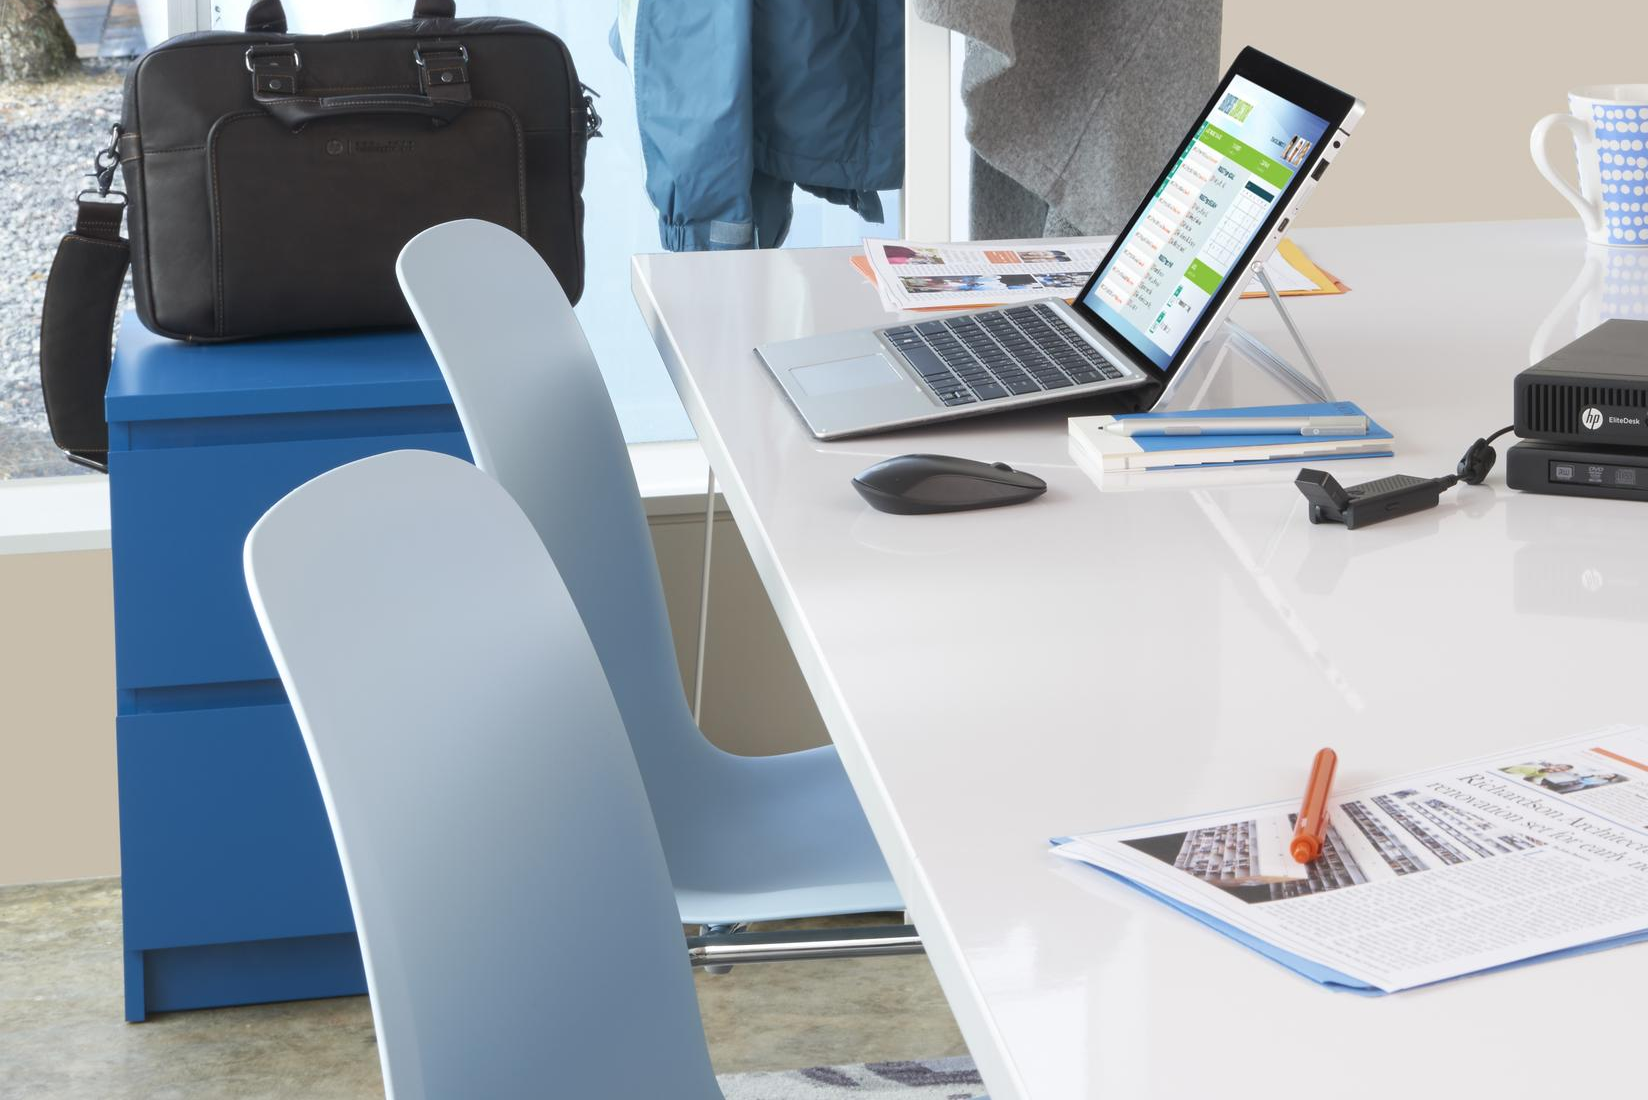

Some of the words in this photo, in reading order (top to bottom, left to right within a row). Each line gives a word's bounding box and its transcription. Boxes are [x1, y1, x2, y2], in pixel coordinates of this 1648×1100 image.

[1584, 408, 1602, 430] hp
[1608, 416, 1640, 425] EliteDesk
[1458, 773, 1564, 821] Richardson
[1427, 782, 1523, 822] renovation
[1521, 819, 1552, 833] set
[1549, 829, 1582, 844] for
[1579, 841, 1629, 862] early
